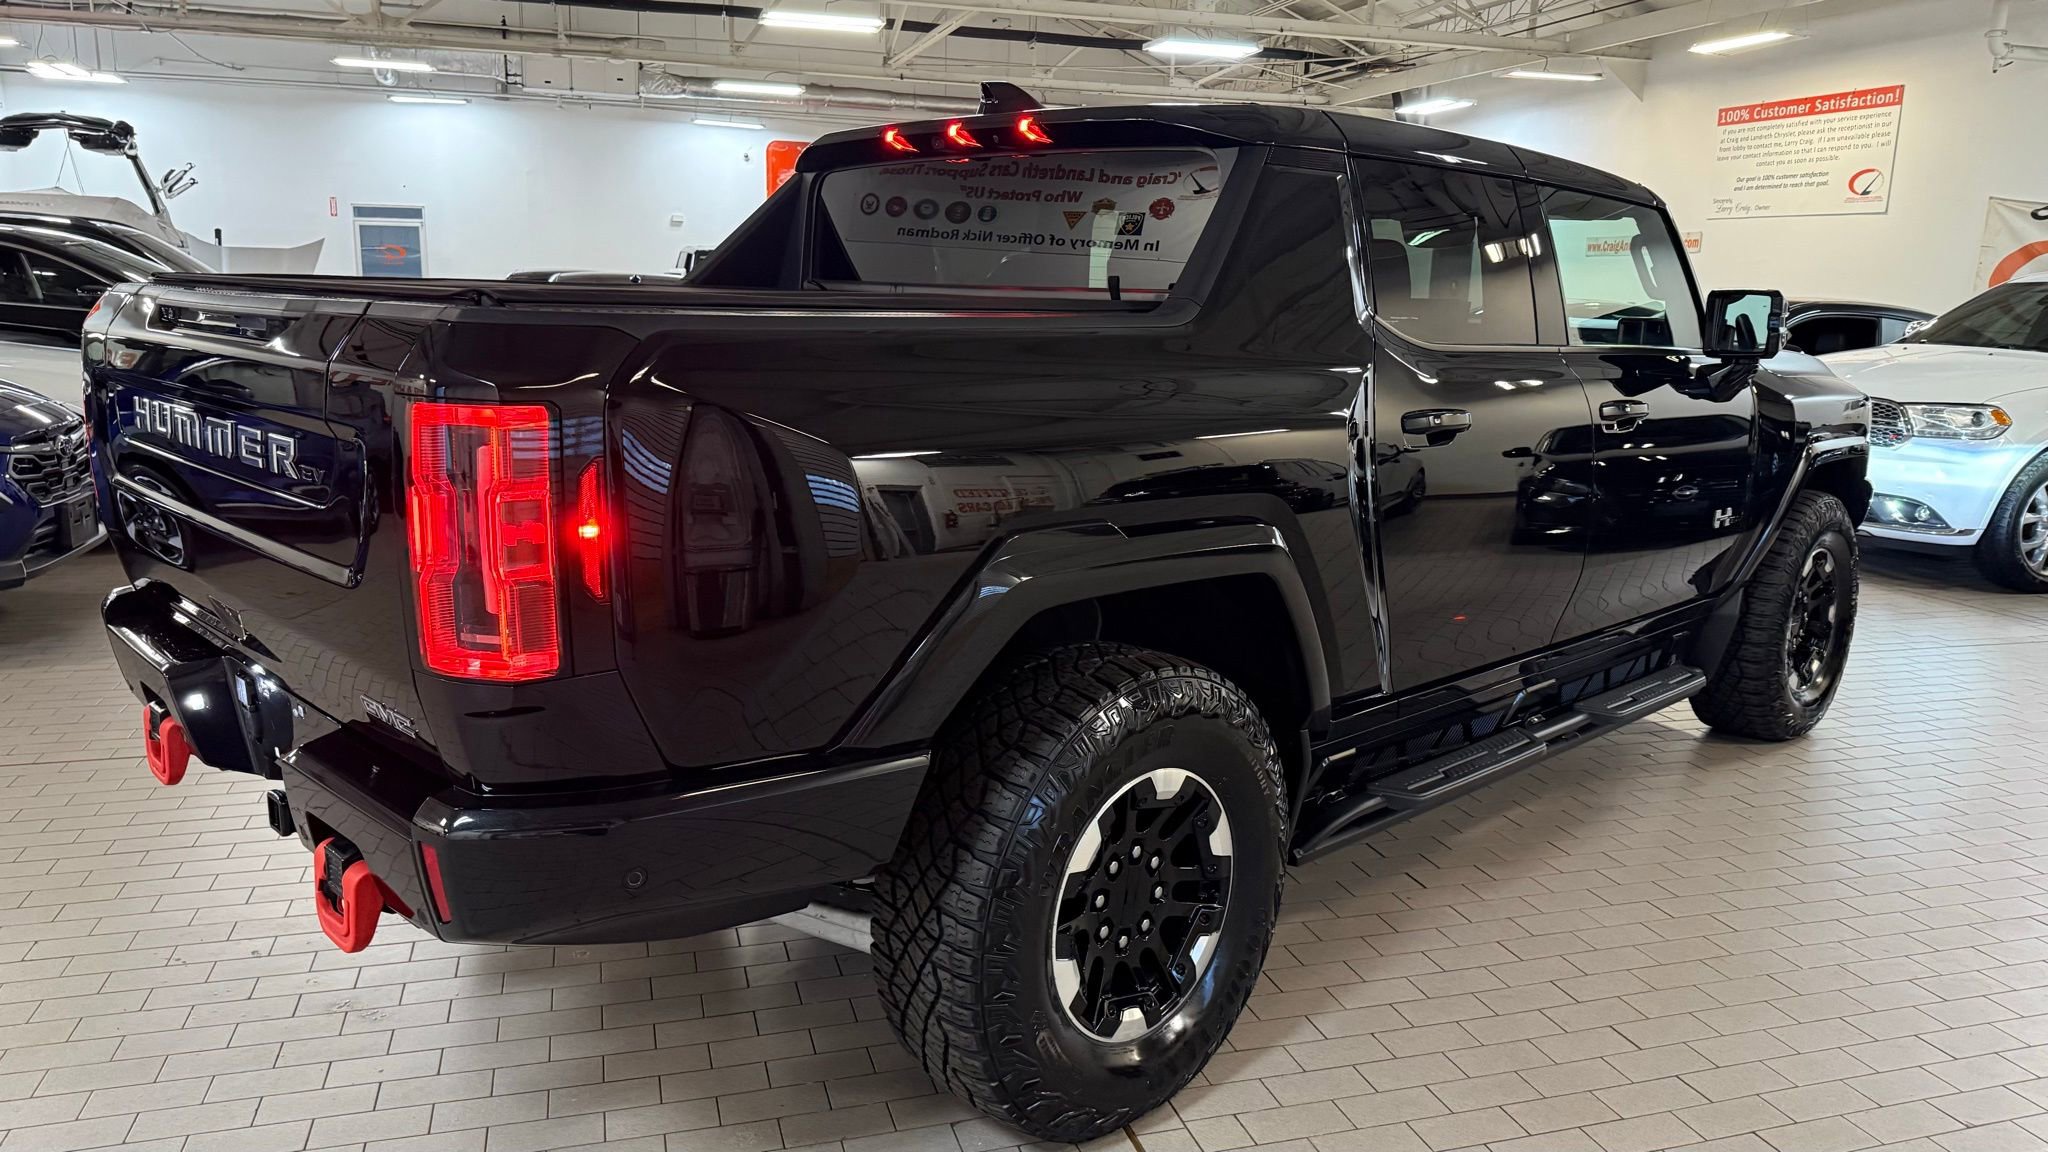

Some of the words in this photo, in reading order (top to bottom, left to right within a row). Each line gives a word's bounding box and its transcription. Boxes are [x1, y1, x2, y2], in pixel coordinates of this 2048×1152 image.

[1720, 108, 1750, 124] 100%
[1754, 103, 1811, 120] Customer
[1815, 88, 1900, 112] Satisfaction!
[1750, 132, 1773, 141] Landreth
[1797, 128, 1815, 137] please
[1817, 126, 1826, 134] ask
[1838, 122, 1873, 132] receptionist
[1757, 123, 1785, 132] completely
[1786, 120, 1809, 128] satisfied
[1859, 111, 1892, 120] experience
[1742, 152, 1762, 160] contact
[1762, 150, 1793, 158] information
[1828, 144, 1851, 152] respond
[1880, 139, 1892, 147] will
[1753, 142, 1773, 150] contact
[1785, 139, 1798, 147] Larry
[1837, 132, 1870, 141] unavailable
[1871, 131, 1891, 139] please
[1816, 154, 1841, 163] possible.
[1754, 183, 1782, 191] determined
[1587, 240, 1631, 254] www.CraigAn
[132, 395, 300, 480] HUMMER
[360, 694, 417, 739] GMC
